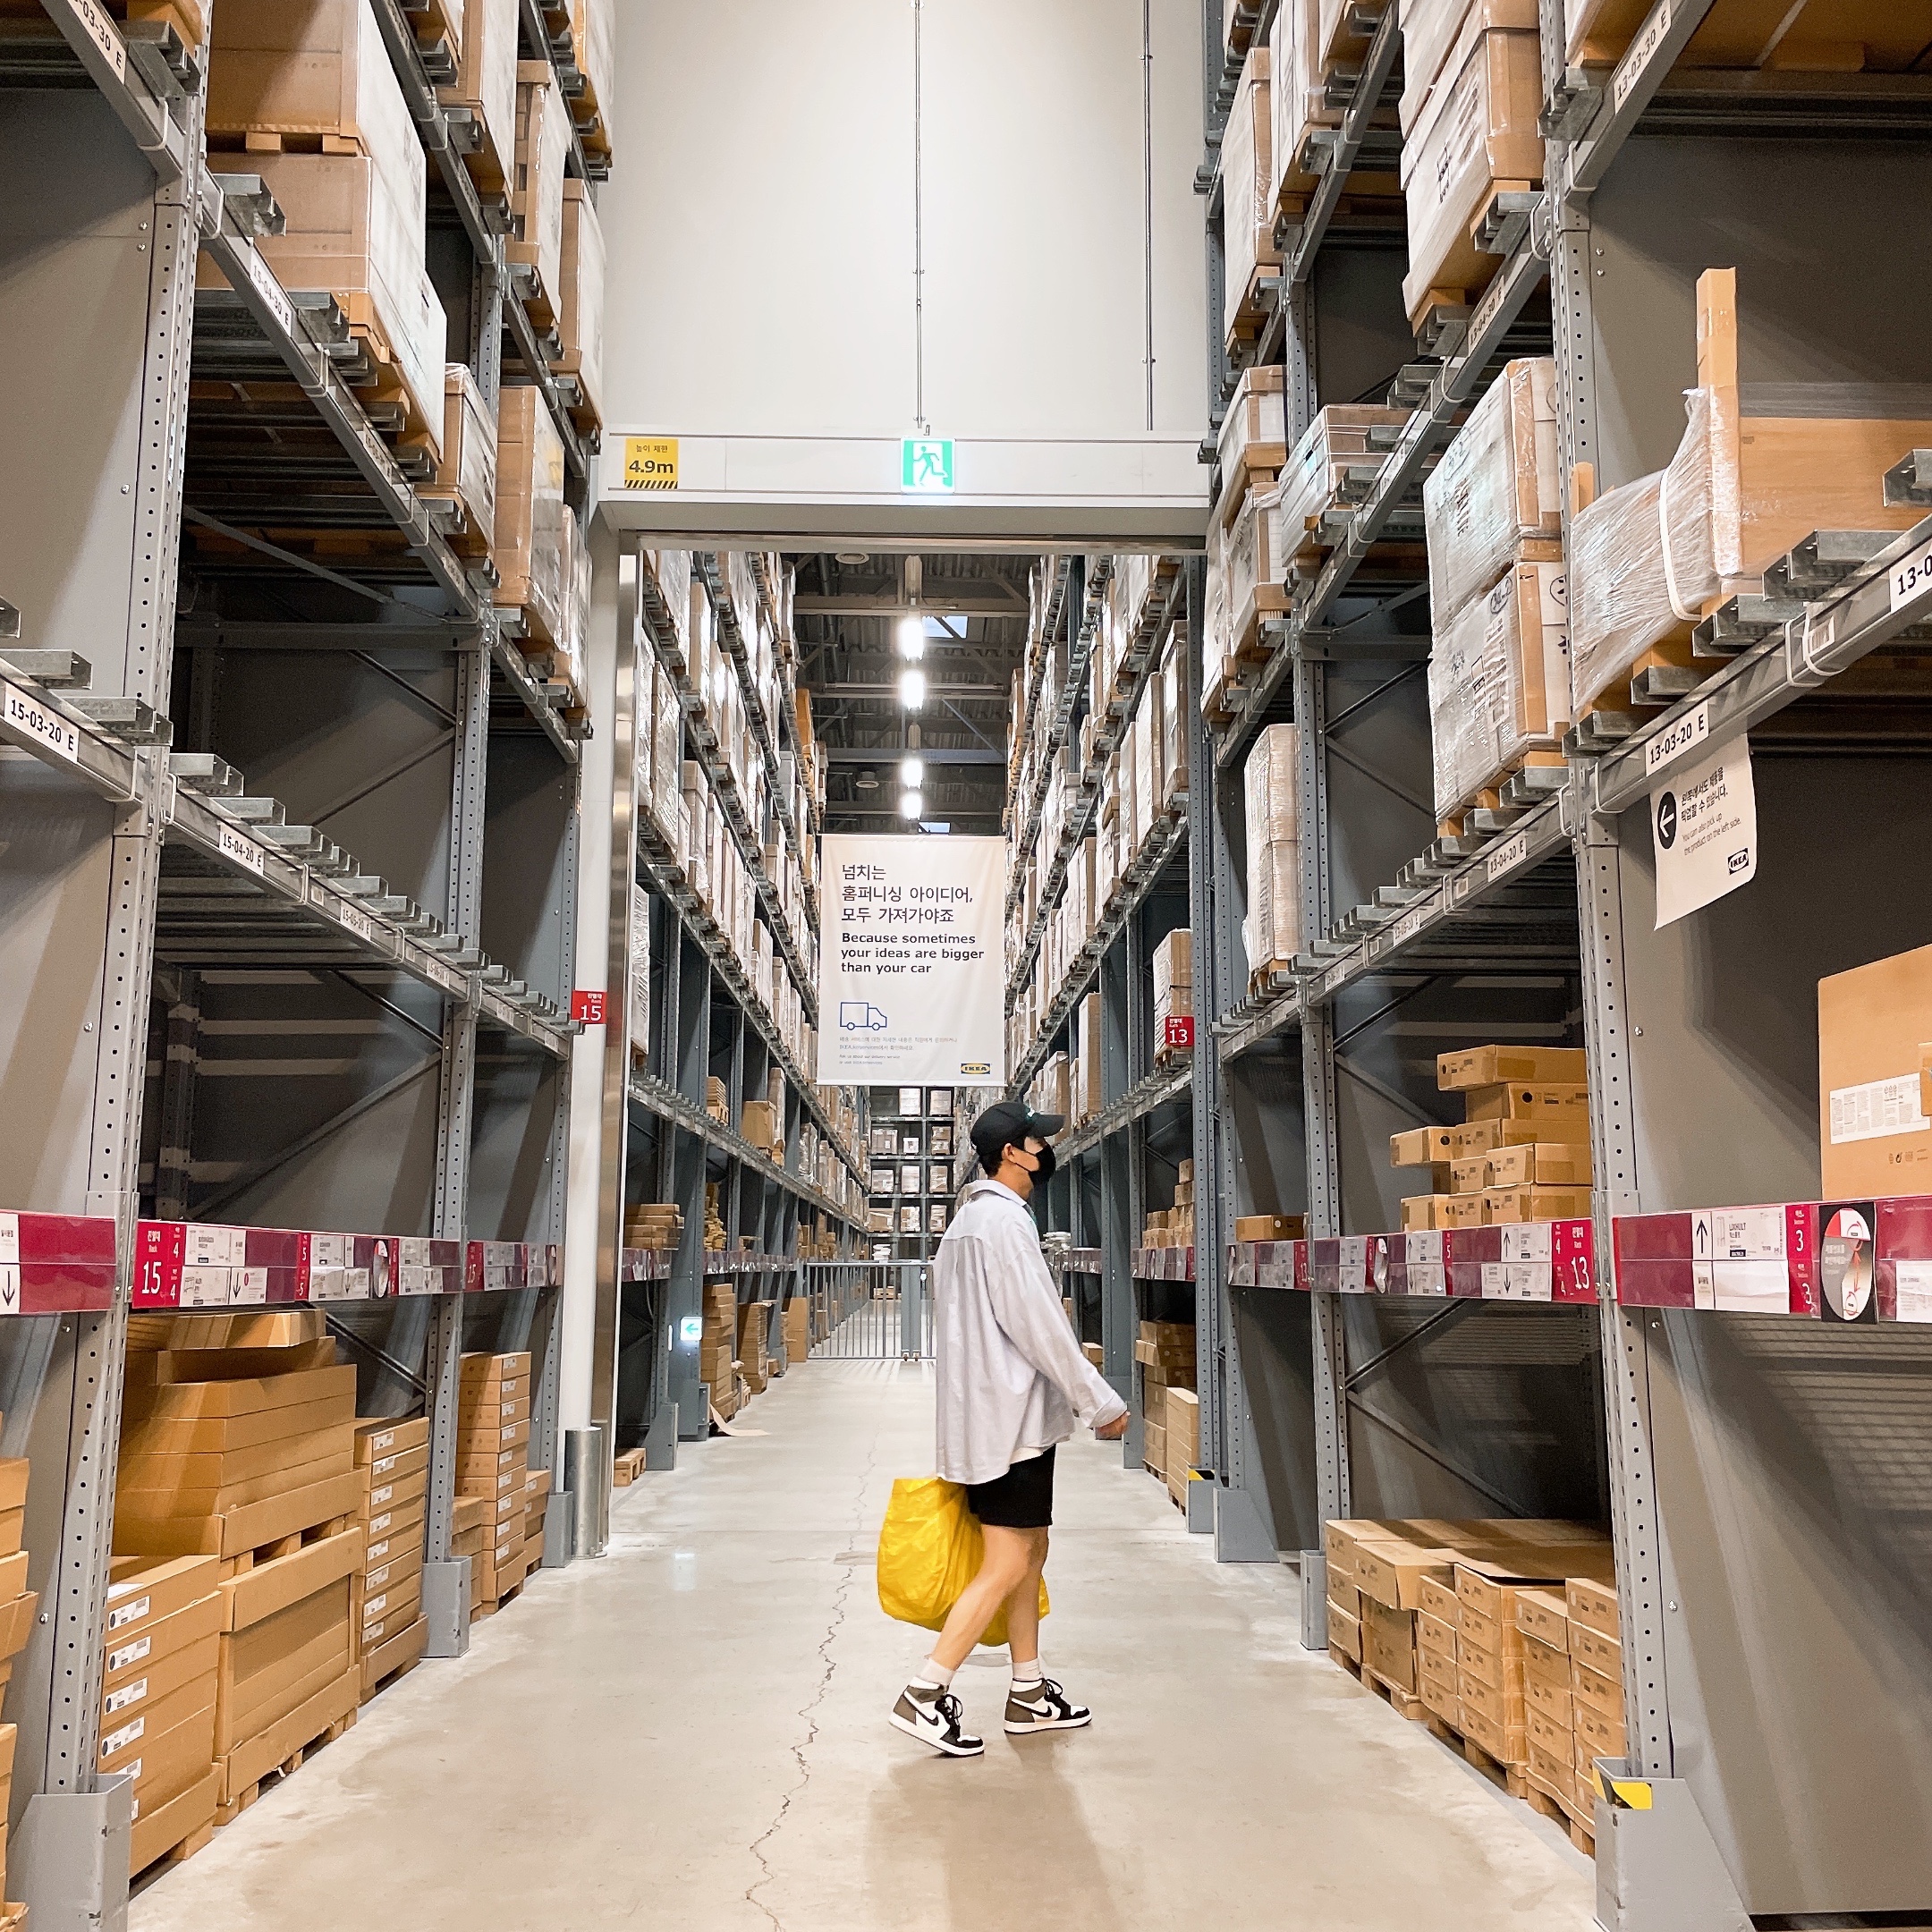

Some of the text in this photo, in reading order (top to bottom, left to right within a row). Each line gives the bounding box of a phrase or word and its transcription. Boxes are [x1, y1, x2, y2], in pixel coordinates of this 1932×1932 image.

[74, 0, 123, 70] -03-30 E
[1617, 10, 1667, 101] 13-03-30 E
[252, 264, 290, 326] 15-04-30 E
[1470, 288, 1503, 346] 13-04-30 E
[636, 444, 650, 453] 높이
[628, 460, 674, 474] 4.9m
[10, 699, 74, 752] 15-03-20 E
[1649, 713, 1705, 765] 13-03-20 E
[1699, 799, 1705, 813] 수
[1682, 812, 1723, 842] You can also pick up
[1683, 845, 1691, 856] the
[1690, 837, 1707, 854] product
[1706, 833, 1713, 842] on
[1713, 827, 1721, 838] the
[1721, 821, 1730, 833] left
[223, 833, 262, 868] 15-04-20 E
[1489, 839, 1524, 874] 13-04-20 E
[842, 864, 886, 881] 넘치는
[842, 885, 973, 903] 홈퍼니싱 아이디어,
[841, 907, 954, 924] 모두 가져가야죠
[842, 932, 976, 945] Because sometimes
[841, 947, 985, 962] your ideas are bigger
[841, 962, 932, 976] than your car
[580, 1004, 602, 1021] 15
[1169, 1029, 1188, 1044] 13
[1555, 1238, 1561, 1255] 4
[1795, 1229, 1804, 1252] 3
[173, 1241, 180, 1258] 4
[301, 1247, 307, 1261] 5
[1446, 1244, 1451, 1258] 5
[141, 1260, 162, 1294] 15
[1571, 1256, 1590, 1290] 13
[169, 1284, 176, 1301] 4
[299, 1282, 304, 1296] 5
[1801, 1282, 1812, 1305] 3
